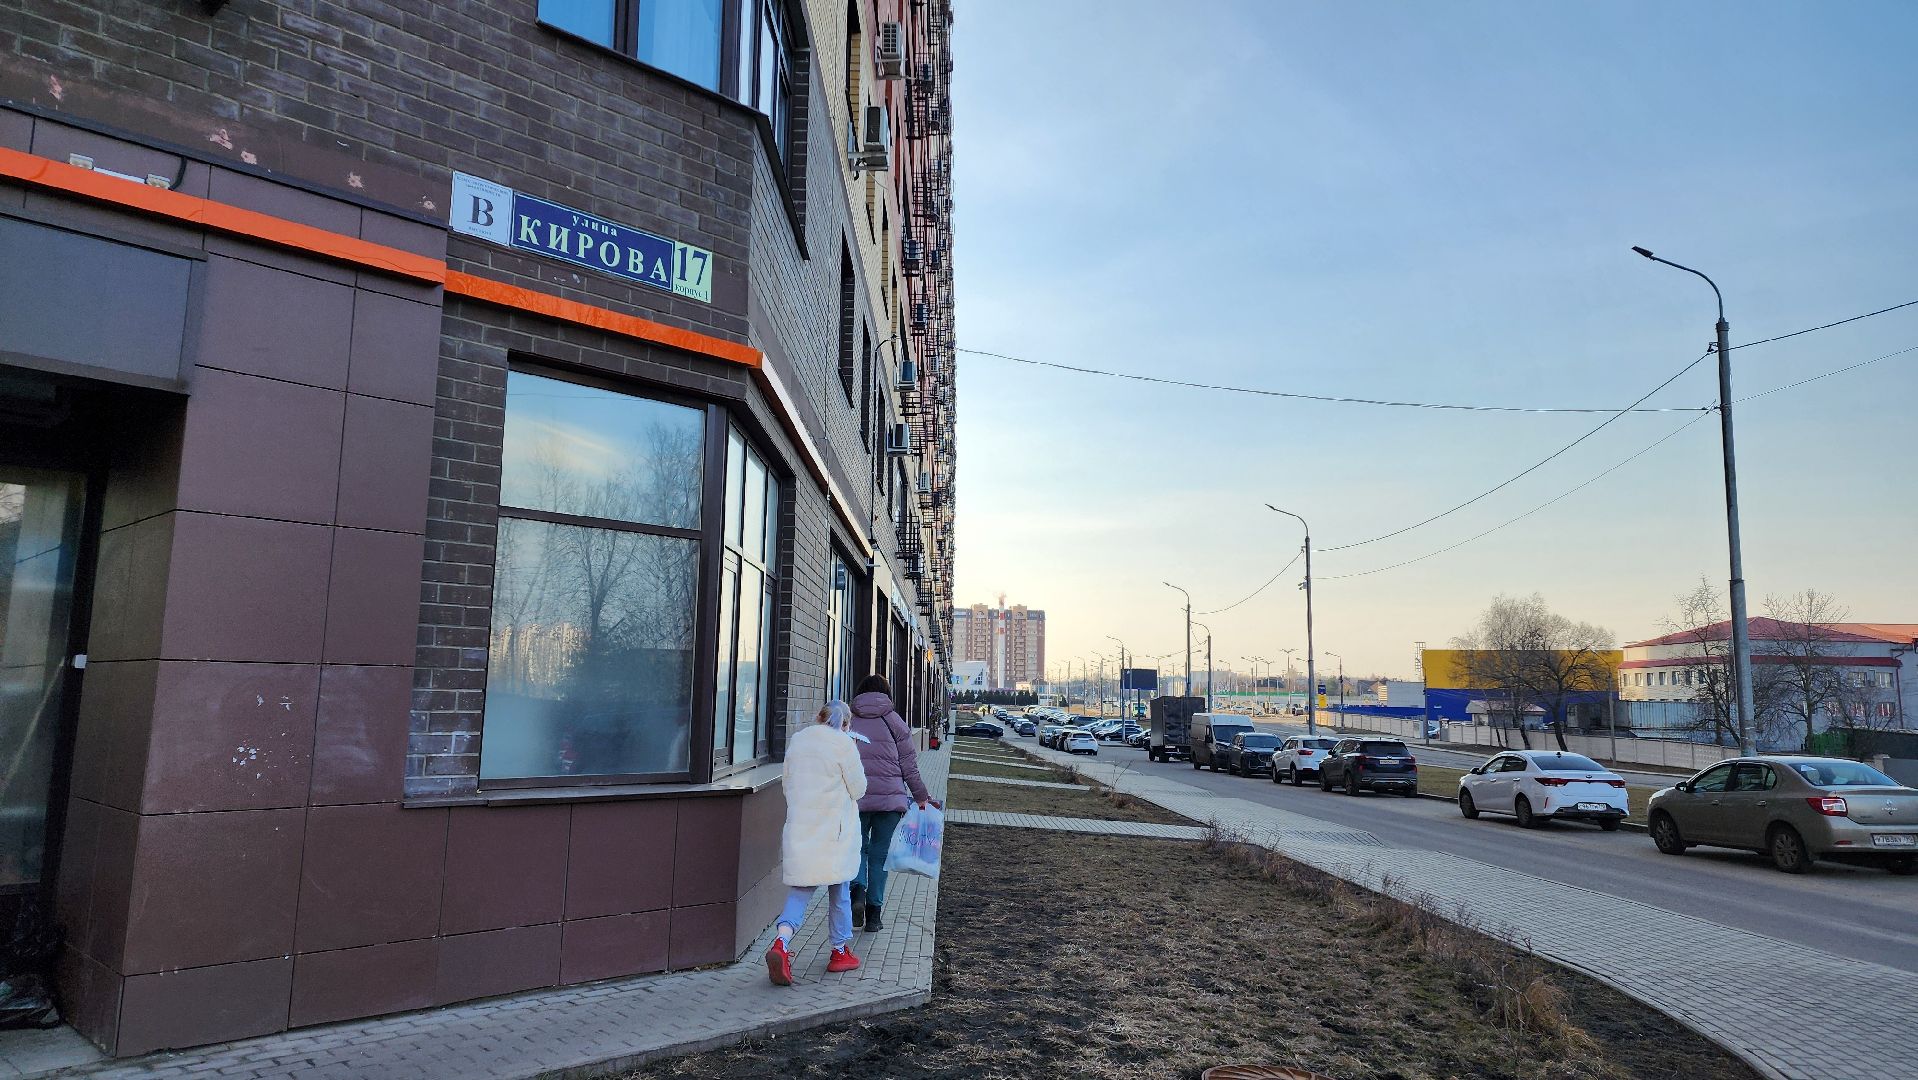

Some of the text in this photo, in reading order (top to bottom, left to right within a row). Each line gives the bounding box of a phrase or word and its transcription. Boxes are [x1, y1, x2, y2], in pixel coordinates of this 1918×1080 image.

[468, 195, 494, 227] В
[572, 215, 618, 237] улица
[518, 214, 710, 286] КИРОВА 17
[675, 284, 702, 299] корпус
